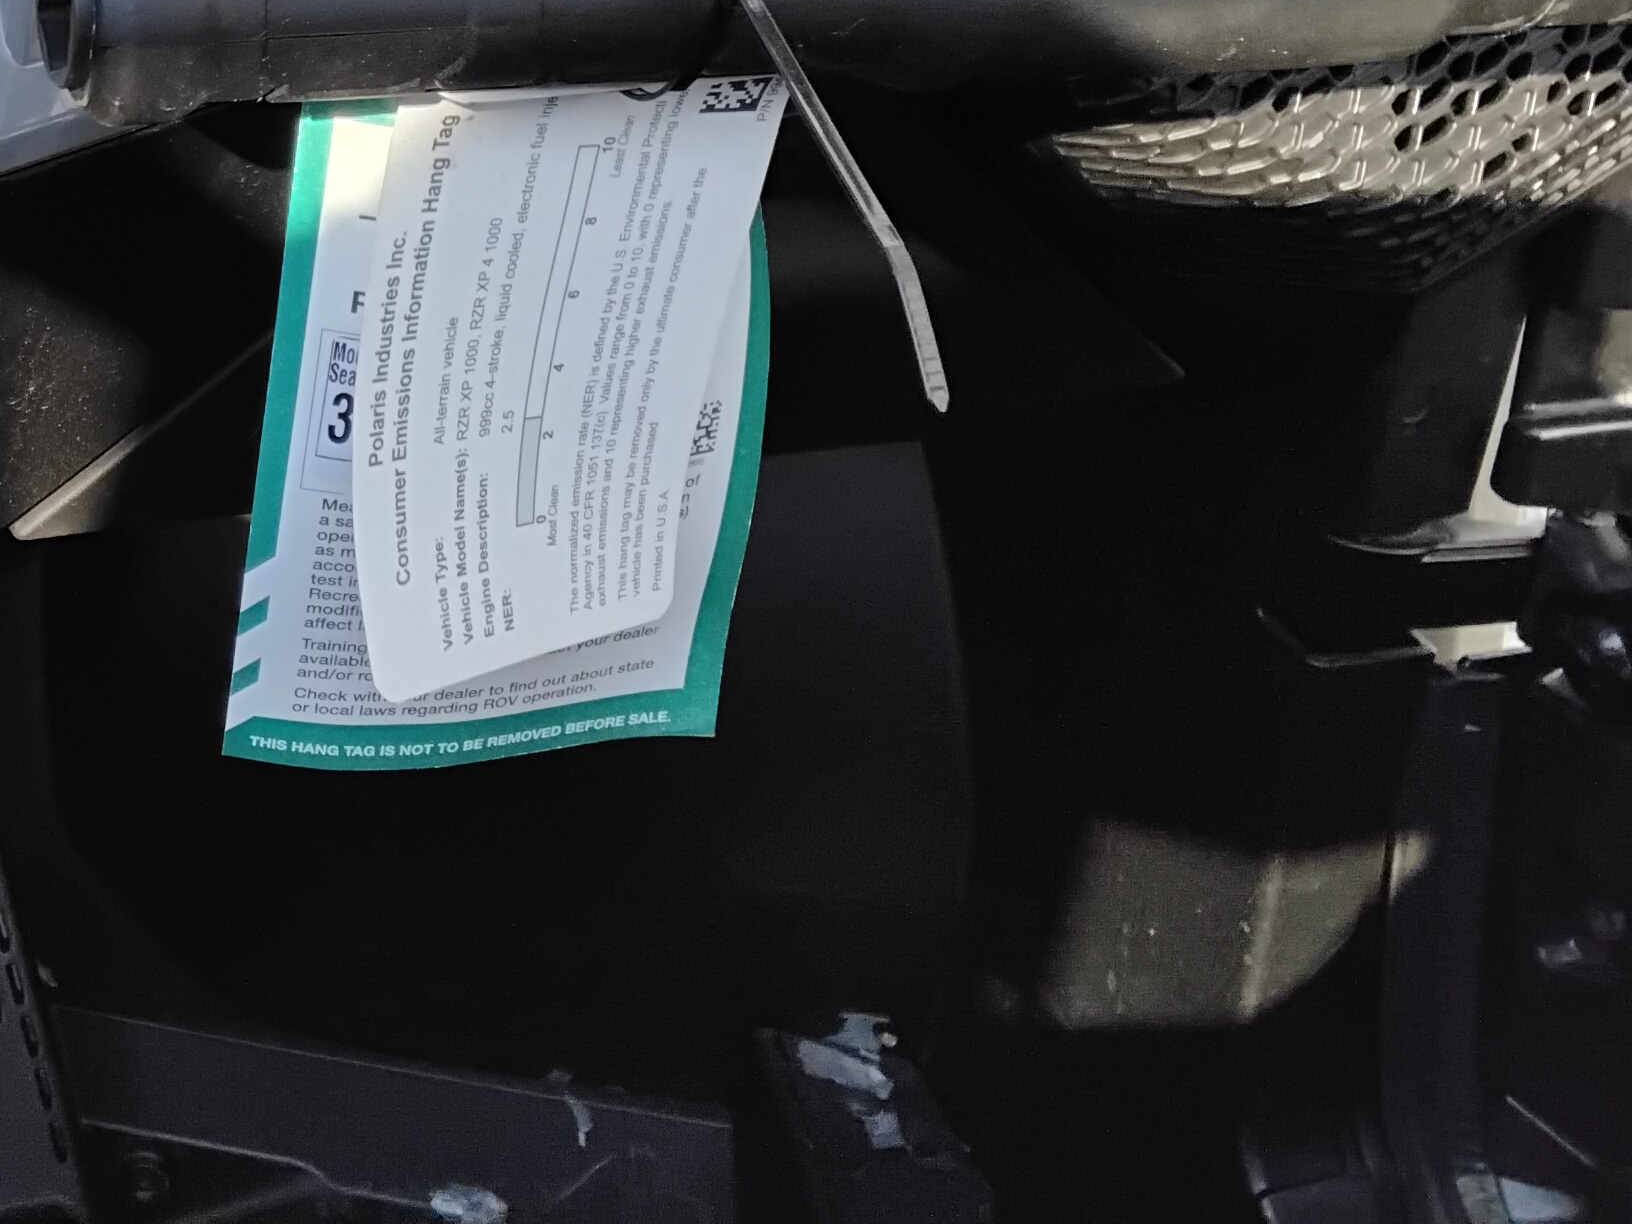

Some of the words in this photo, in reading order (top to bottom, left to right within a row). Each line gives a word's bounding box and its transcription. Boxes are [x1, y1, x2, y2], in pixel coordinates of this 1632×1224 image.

[432, 115, 460, 150] Tag
[532, 123, 548, 148] fuel
[610, 148, 627, 178] Least
[647, 121, 678, 200] representing
[693, 168, 708, 188] the
[422, 158, 450, 213] Hang
[517, 152, 542, 224] electronic
[618, 152, 652, 242] Environmental
[685, 191, 702, 219] after
[485, 218, 503, 252] 1000
[633, 215, 652, 240] with
[386, 231, 407, 269] Inc.
[481, 258, 494, 267] 4
[504, 228, 526, 278] cooled,
[668, 223, 692, 282] consumer
[401, 220, 435, 342] Information
[475, 271, 490, 292] XP
[542, 430, 554, 440] 2
[554, 363, 564, 372] 4
[568, 290, 580, 299] 6
[585, 216, 597, 226] 8
[602, 136, 616, 153] 10
[607, 276, 620, 295] the
[626, 266, 639, 278] to
[634, 266, 656, 314] exhaust
[470, 296, 486, 330] RZR
[494, 284, 513, 321] liquid
[602, 298, 616, 314] by
[616, 292, 632, 321] from
[654, 286, 676, 334] ultimate
[372, 276, 400, 383] Industries
[442, 317, 458, 369] vehicle
[591, 317, 610, 362] defined
[610, 324, 626, 359] range
[624, 318, 642, 356] higher
[650, 336, 663, 356] the
[464, 334, 481, 375] 1000,
[485, 326, 506, 388] 4-stroke,
[588, 366, 599, 376] is
[647, 359, 660, 374] by
[460, 380, 474, 402] XP
[580, 379, 599, 418] (NER)
[598, 363, 616, 404] Values
[610, 360, 634, 436] representing
[640, 377, 656, 402] only
[392, 348, 416, 462] Emissions
[434, 374, 452, 444] All-terrain
[457, 406, 470, 440] RZR
[479, 392, 494, 437] 999cc
[501, 410, 514, 434] 2.5
[368, 390, 386, 467] Polaris
[577, 422, 590, 446] rate
[606, 439, 616, 454] 10
[628, 406, 647, 458] removed
[454, 448, 469, 520] Name(s):
[570, 450, 585, 506] emission
[604, 458, 613, 482] and
[625, 462, 637, 478] be
[548, 484, 559, 516] Clean
[584, 489, 595, 520] CFR
[624, 481, 635, 509] may
[635, 489, 648, 520] been
[392, 468, 410, 586] Consumer
[477, 473, 490, 572] Description:
[547, 520, 557, 546] Most
[583, 523, 593, 540] 40
[597, 485, 611, 550] emissions
[620, 512, 633, 533] tag
[633, 523, 644, 548] has
[455, 526, 468, 577] Model
[568, 511, 579, 583] normalized
[583, 544, 592, 556] in
[618, 536, 630, 569] hang
[654, 531, 664, 542] in
[433, 537, 448, 583] Type:
[632, 551, 642, 597] vehicle
[652, 546, 664, 592] Printed
[311, 574, 343, 587] test
[583, 560, 595, 610] Agency
[596, 553, 607, 606] exhaust
[618, 572, 628, 600] This
[438, 588, 454, 651] Vehicle
[459, 582, 474, 645] Vehicle
[480, 578, 495, 638] Engine
[502, 589, 515, 632] NER:
[570, 588, 579, 616] The
[304, 617, 352, 631] affect
[613, 626, 660, 643] dealer
[301, 637, 367, 654] Training
[294, 687, 347, 702] Check
[434, 686, 484, 702] dealer
[489, 685, 504, 696] to
[509, 679, 537, 694] find
[542, 675, 566, 688] out
[570, 667, 613, 683] about
[617, 659, 655, 674] state
[297, 668, 353, 681] and/or
[292, 703, 307, 713] or
[314, 703, 354, 716] local
[359, 706, 396, 716] laws
[401, 700, 478, 718] regarding
[483, 695, 518, 711] ROV
[522, 681, 597, 705] operation.
[249, 735, 288, 751] THIS
[291, 741, 339, 757] HANG
[343, 745, 375, 757] TAG
[380, 745, 395, 757] IS
[399, 743, 433, 757] NOT
[438, 741, 459, 755] TO
[463, 738, 484, 752] BE
[487, 725, 562, 748] REMOVED
[565, 715, 625, 736] BEFORE
[628, 710, 672, 727] SALE.
